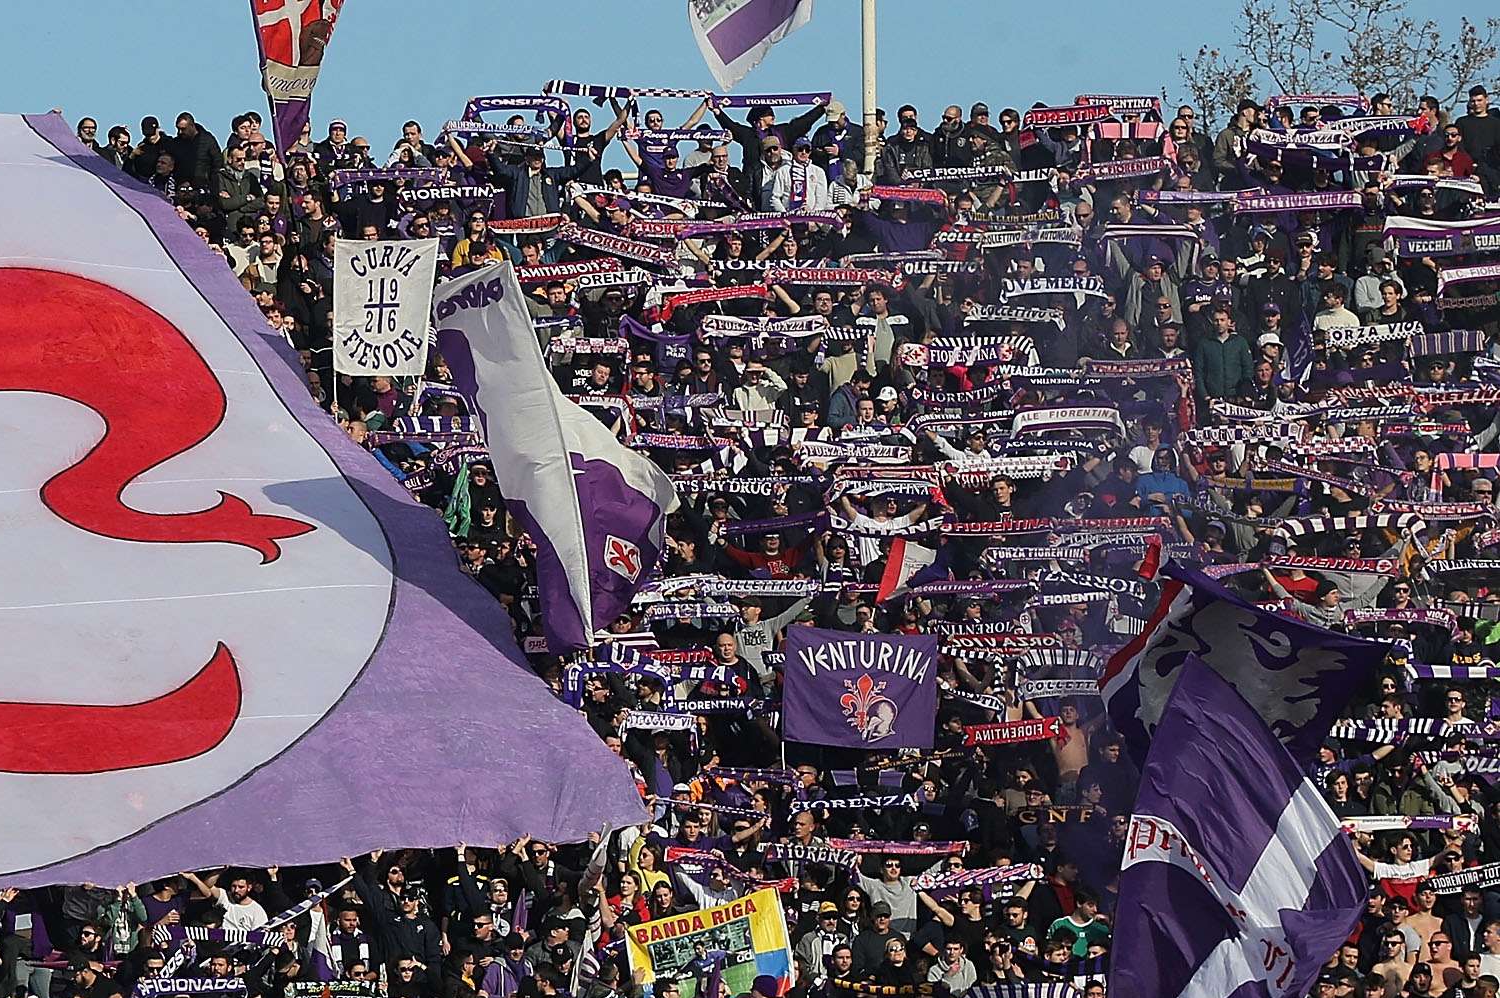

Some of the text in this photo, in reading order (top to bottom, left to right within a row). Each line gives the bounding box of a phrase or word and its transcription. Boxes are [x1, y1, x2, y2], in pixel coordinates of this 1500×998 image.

[745, 97, 800, 105] FIORENTINA
[642, 129, 669, 140] Rocco
[935, 166, 1011, 177] FIORENTIN
[402, 184, 490, 201] FIORENTIN
[581, 230, 662, 260] FIORENTINA
[1408, 238, 1453, 253] VECCHIA
[349, 244, 422, 278] CURVA
[757, 318, 810, 333] RAGAZZI
[1331, 325, 1378, 341] ORZA
[341, 327, 425, 371] FIESOLE
[1048, 407, 1119, 422] FIORENTINA
[1327, 404, 1413, 420] FIORENTINA
[702, 480, 724, 493] MY
[729, 480, 773, 496] DRUG
[952, 518, 1052, 534] FIORENTINA
[1027, 548, 1085, 560] FIORENTINA
[1276, 555, 1375, 571] FIORENTINA
[713, 579, 804, 593] COLLETTIVO
[1043, 591, 1110, 605] FIORENTIN
[798, 641, 933, 684] VENTURINA
[678, 700, 746, 710] FIORENTINA
[775, 841, 858, 867] FIORENZA
[635, 899, 758, 944] BANDA RIGA
